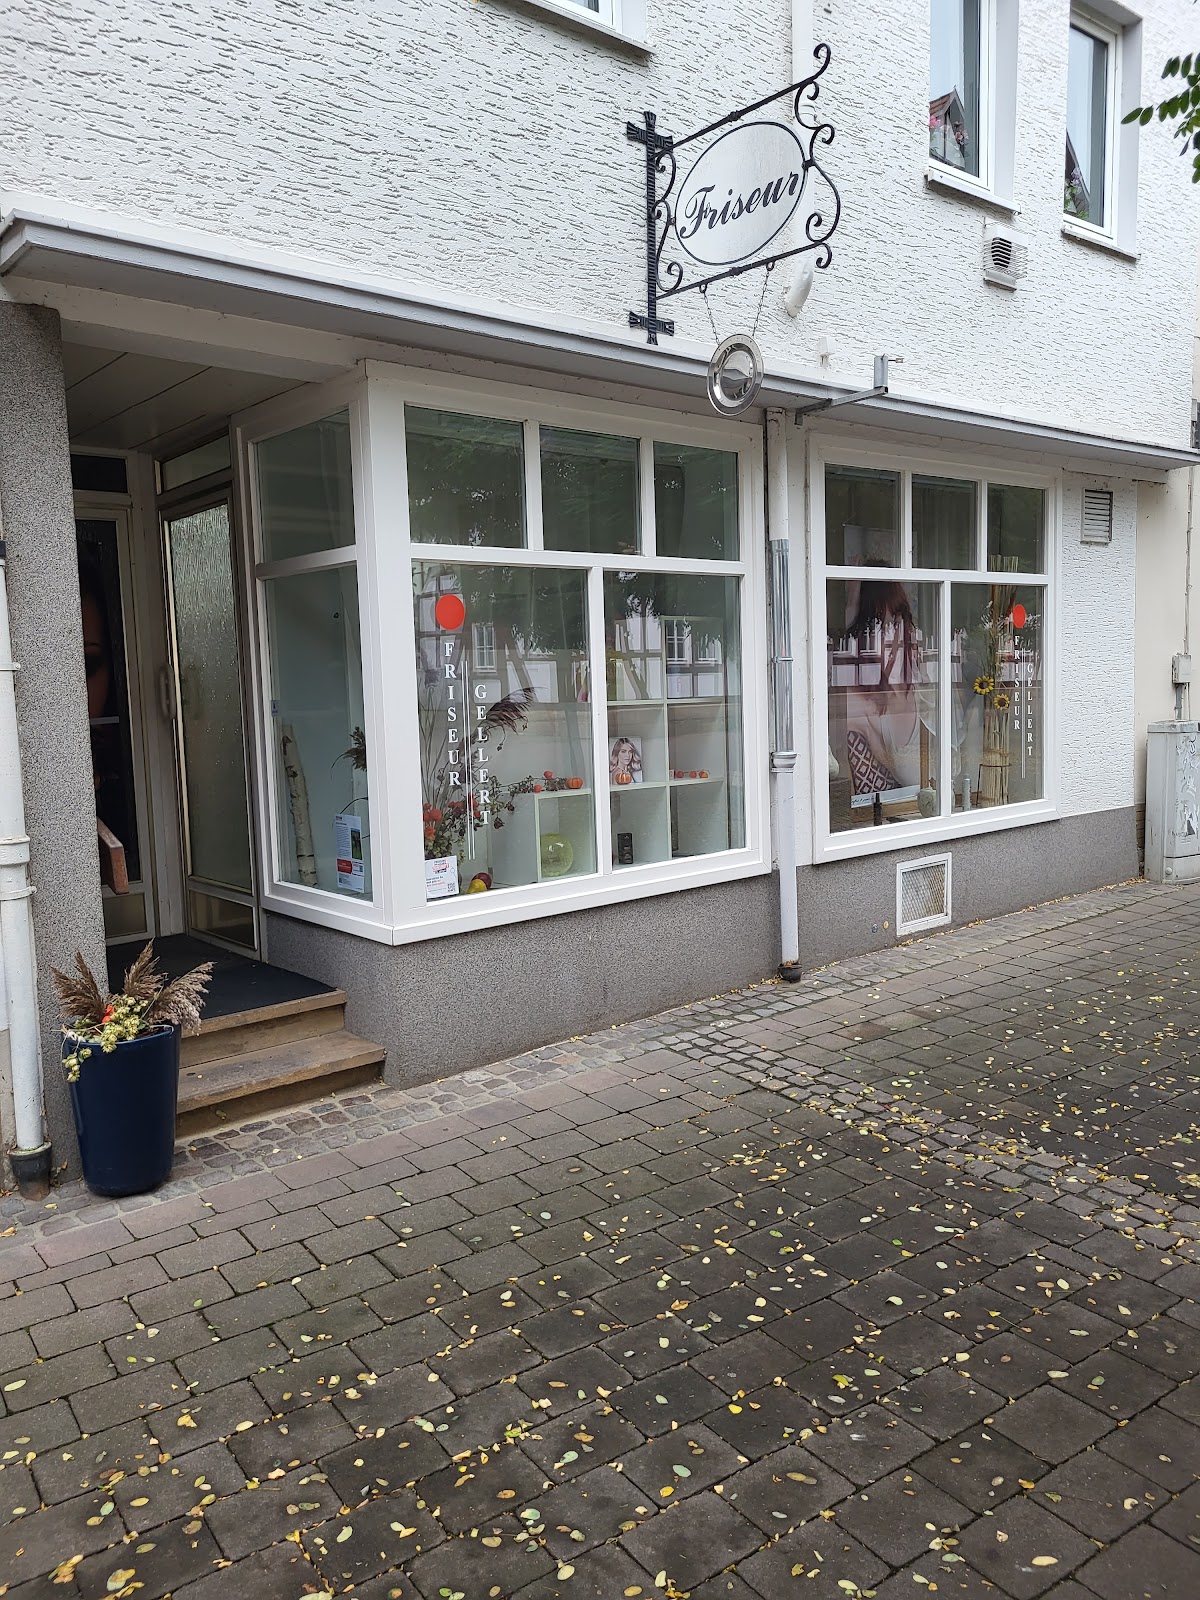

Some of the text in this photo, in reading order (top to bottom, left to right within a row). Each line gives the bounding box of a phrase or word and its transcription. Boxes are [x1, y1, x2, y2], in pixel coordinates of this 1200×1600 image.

[679, 171, 799, 239] Friseur
[444, 642, 461, 787] FRISEUR
[474, 684, 491, 826] GELLERT
